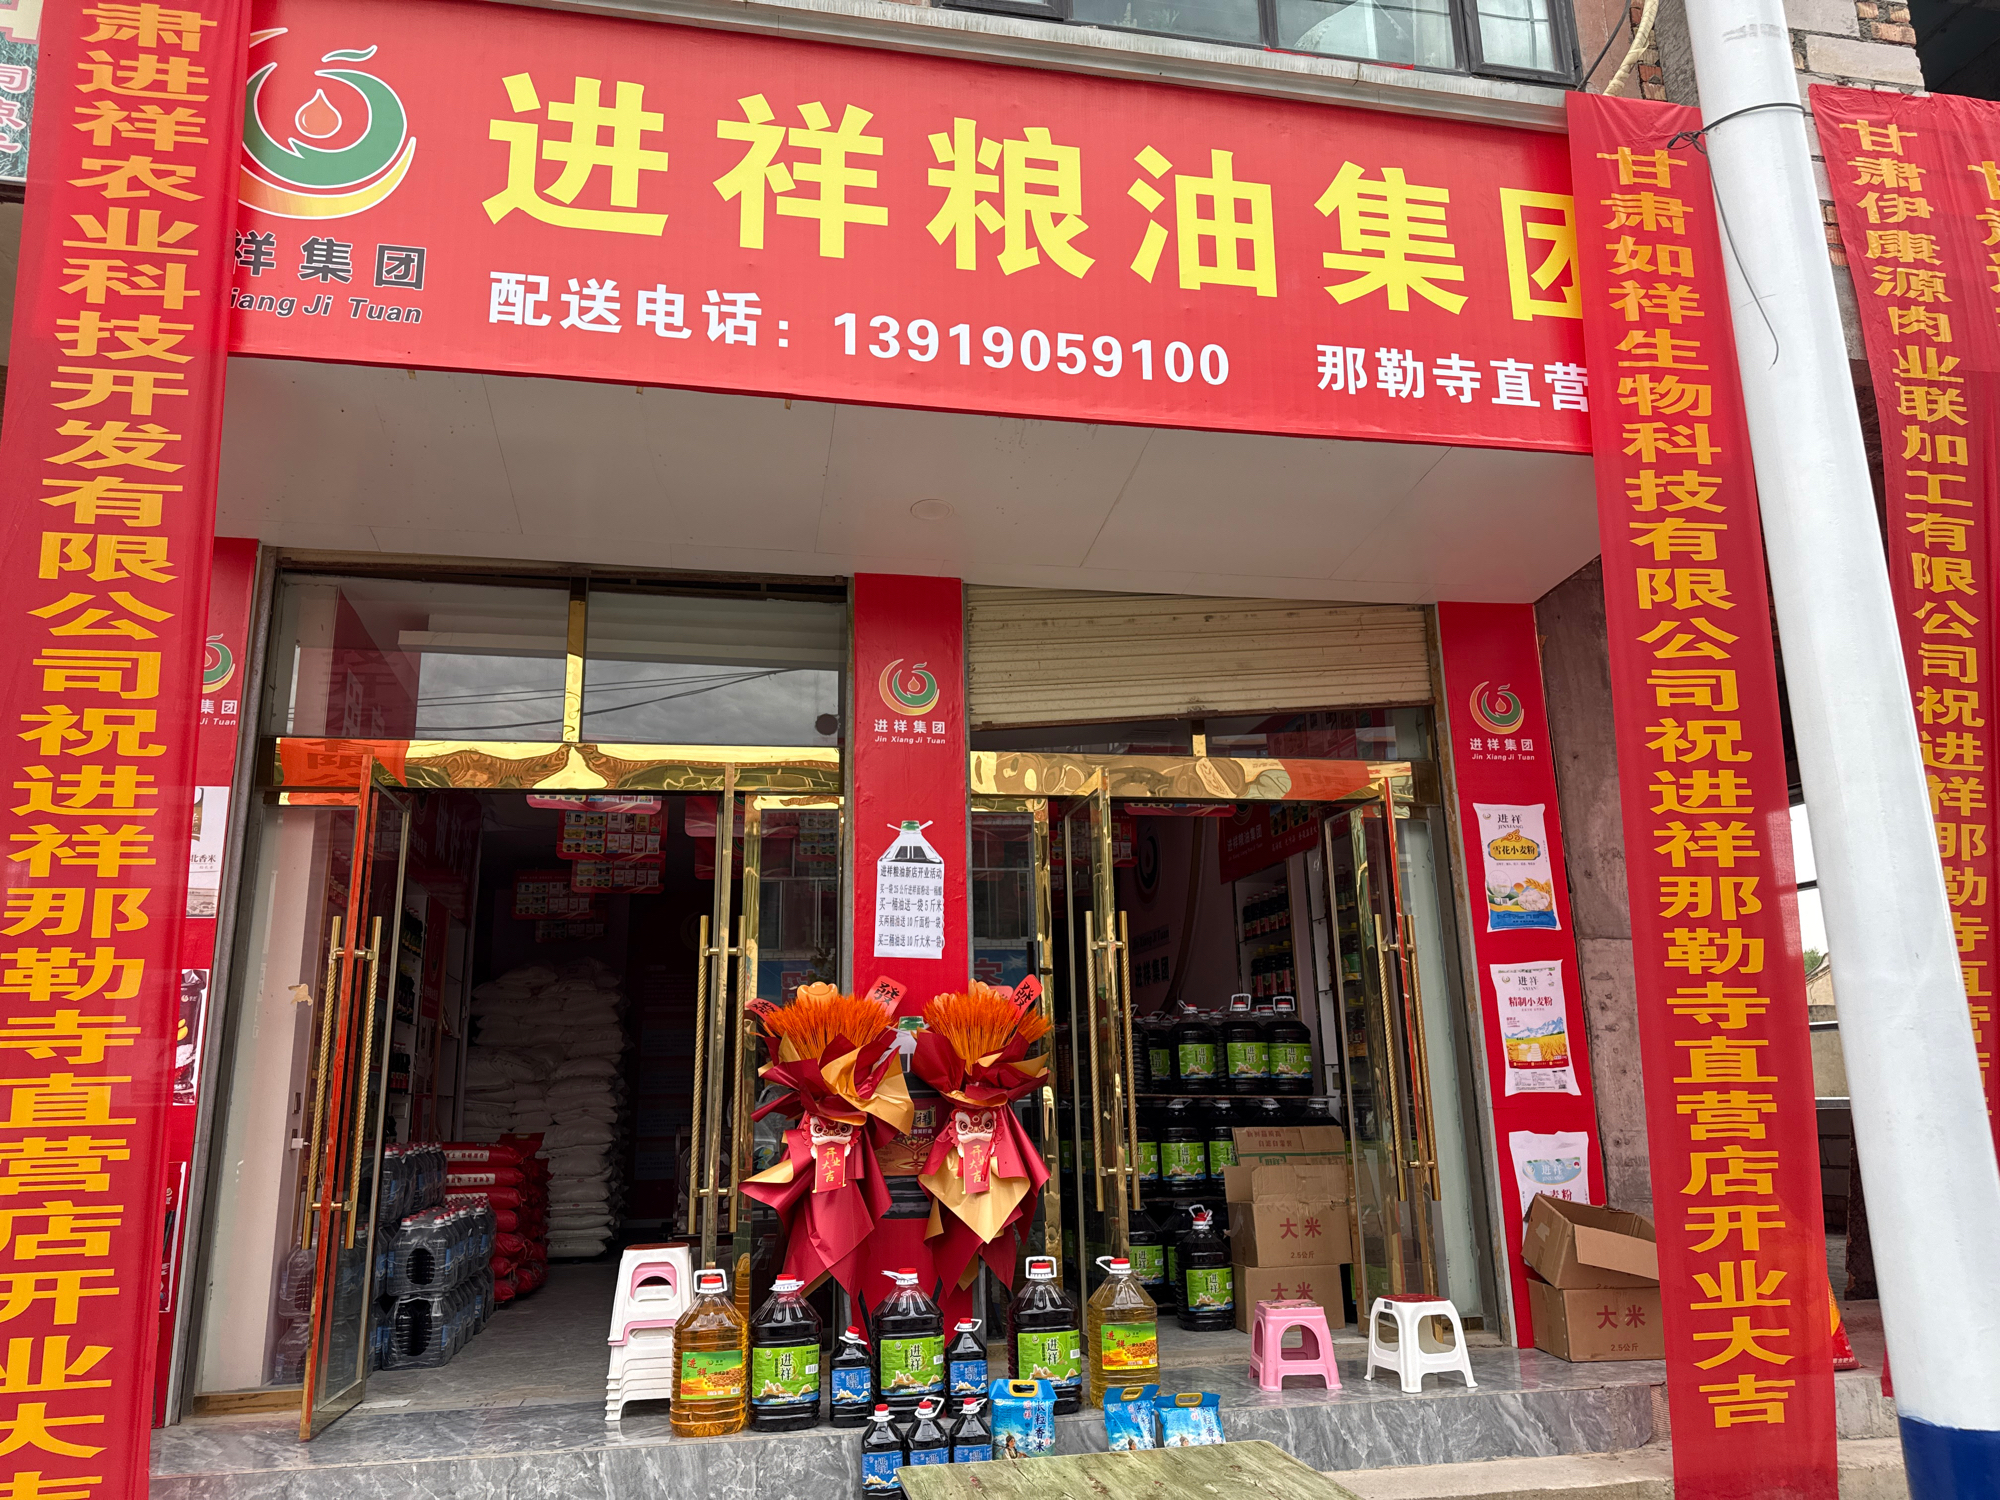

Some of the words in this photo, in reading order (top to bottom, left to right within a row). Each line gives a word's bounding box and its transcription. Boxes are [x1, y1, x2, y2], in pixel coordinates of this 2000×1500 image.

[483, 72, 1582, 321] 进祥粮油集团
[303, 294, 333, 316] Ji
[349, 298, 422, 324] Tuan
[488, 271, 790, 349] 配送电话：
[834, 312, 1229, 385] 13919059100
[1317, 345, 1589, 413] 那勒寺直营
[201, 699, 237, 714] 集团
[213, 718, 236, 726] Tuan
[874, 719, 945, 734] 进祥集团
[891, 736, 914, 744] Xiang
[1470, 738, 1534, 751] 进祥集团
[1597, 146, 1796, 1428] 甘肃如祥生物科技有限公司祝进祥那勒寺直营店开业大吉
[1498, 814, 1522, 823] 进祥
[1493, 844, 1535, 855] 雪花小麦粉
[880, 865, 942, 879] 进祥粮油新店开业活动
[879, 898, 942, 912] 买一桶油送一袋5斤米
[878, 915, 941, 929] 买两桶油送10斤面粉一袋
[877, 933, 942, 948] 买三桶油送10斤大米一袋
[1518, 976, 1538, 986] 进祥
[1508, 996, 1553, 1008] 精制小麦粉
[916, 1112, 929, 1125] 祥
[821, 1147, 841, 1183] 开业大吉
[1542, 1165, 1563, 1175] 进祥
[1279, 1216, 1322, 1240] 大米
[1290, 1251, 1315, 1259] 2.5公斤
[1210, 1273, 1218, 1293] 进祥
[1271, 1281, 1314, 1300] 大米
[1596, 1304, 1646, 1329] 大米
[1047, 1338, 1058, 1365] 进祥
[1610, 1342, 1639, 1352] 2.5公斤
[910, 1344, 921, 1372] 进祥
[780, 1353, 792, 1381] 进祥
[1035, 1400, 1046, 1453] 长粒香米
